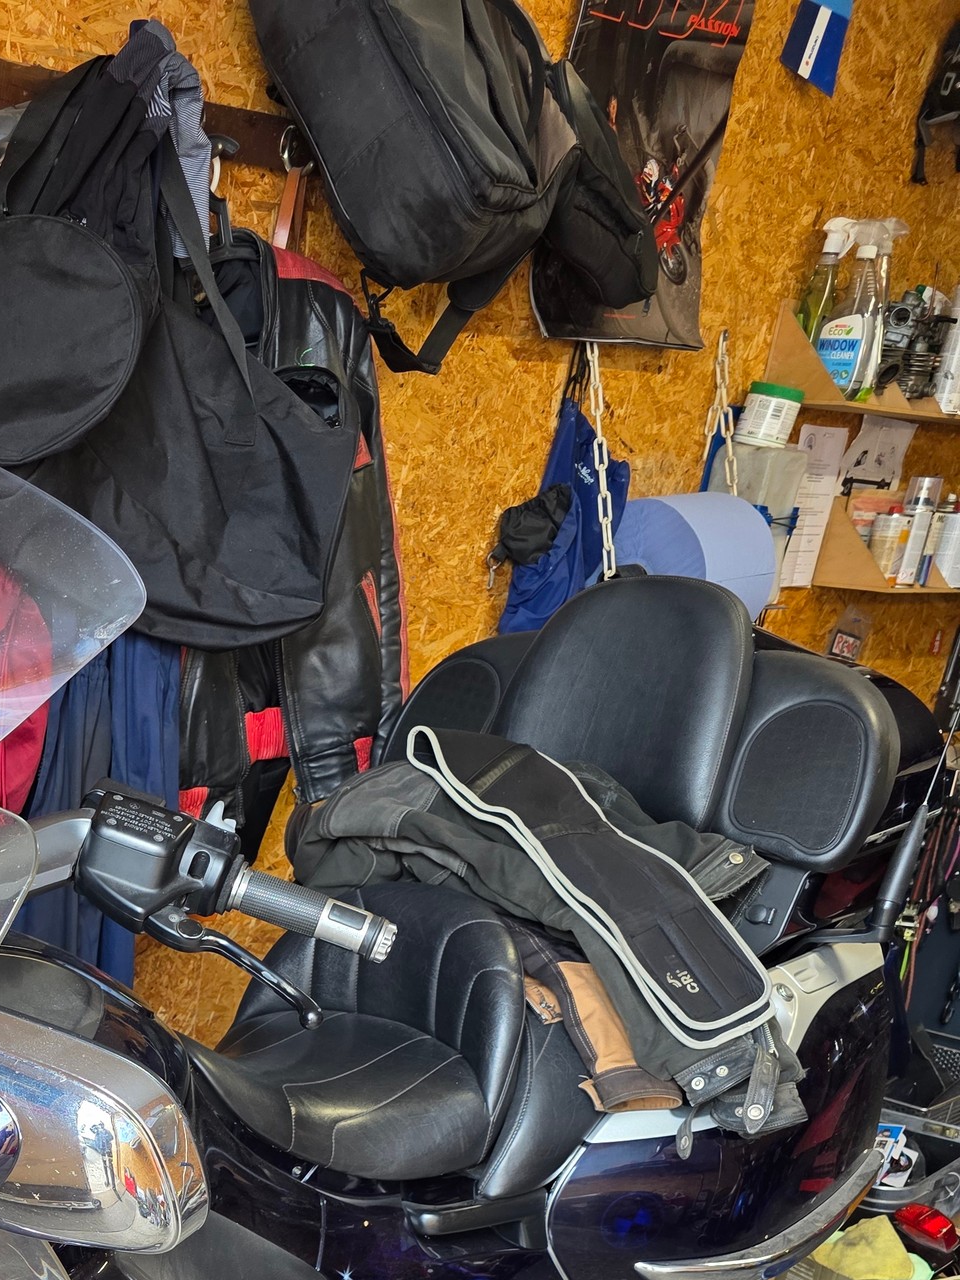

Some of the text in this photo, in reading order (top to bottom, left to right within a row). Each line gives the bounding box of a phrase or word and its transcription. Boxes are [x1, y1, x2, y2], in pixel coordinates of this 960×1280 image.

[687, 15, 741, 37] PASSION
[818, 339, 858, 352] WINDOW
[830, 351, 855, 360] CLEANER
